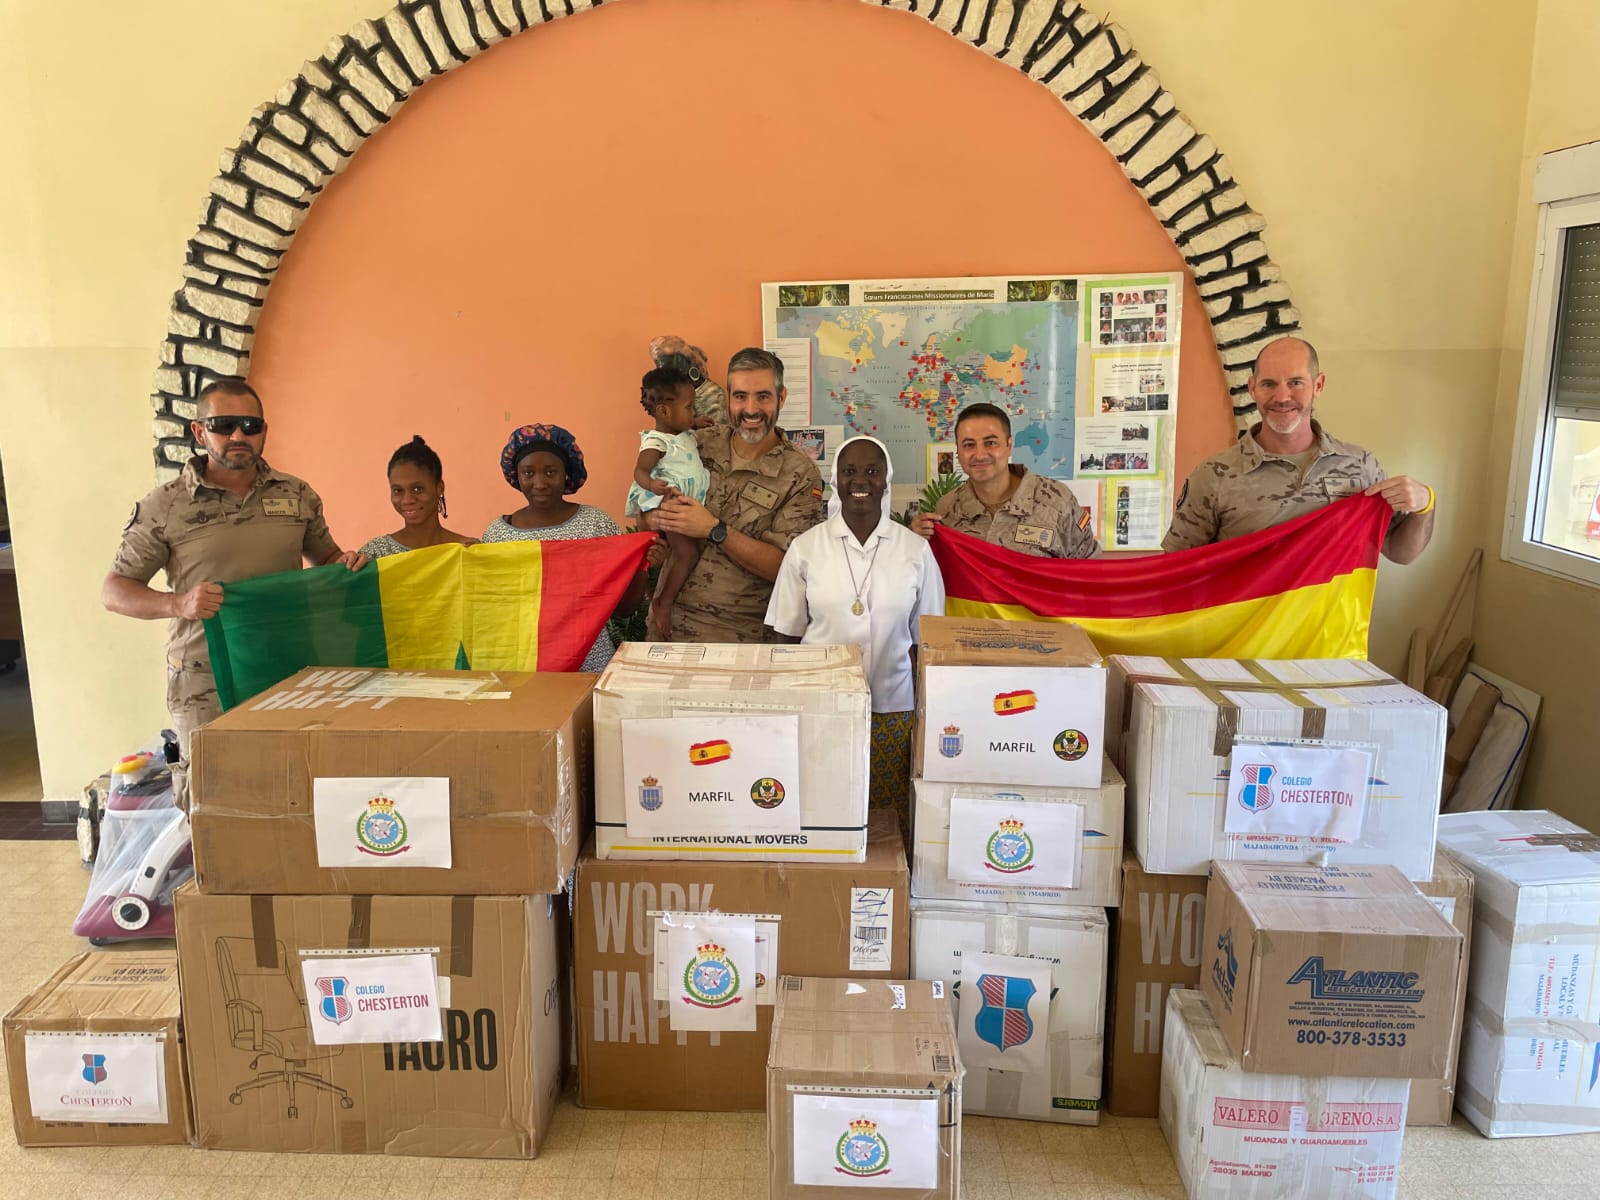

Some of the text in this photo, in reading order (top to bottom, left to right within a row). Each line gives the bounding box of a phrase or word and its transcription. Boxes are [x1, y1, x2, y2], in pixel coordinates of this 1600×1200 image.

[989, 742, 1036, 753] MARFIL
[1282, 776, 1312, 786] COLEGIO
[688, 791, 734, 803] MARFIL
[1280, 789, 1353, 807] CHESTERTON
[754, 834, 808, 845] MOVERS
[1286, 956, 1419, 990] ATLANTIC
[1568, 953, 1580, 997] MUDANZAS
[355, 985, 385, 995] COLEGIO
[1327, 986, 1382, 994] RELOCATION
[357, 993, 429, 1012] CHESTERTON
[1287, 1017, 1415, 1030] www.atlanticrelocation.com
[1296, 1029, 1406, 1047] 800-378-3533
[1057, 1098, 1097, 1111] Movers
[1218, 1106, 1279, 1124] VALERO
[1243, 1135, 1288, 1145] MUDANZAS
[1300, 1138, 1368, 1146] GUARDAMUEBLES
